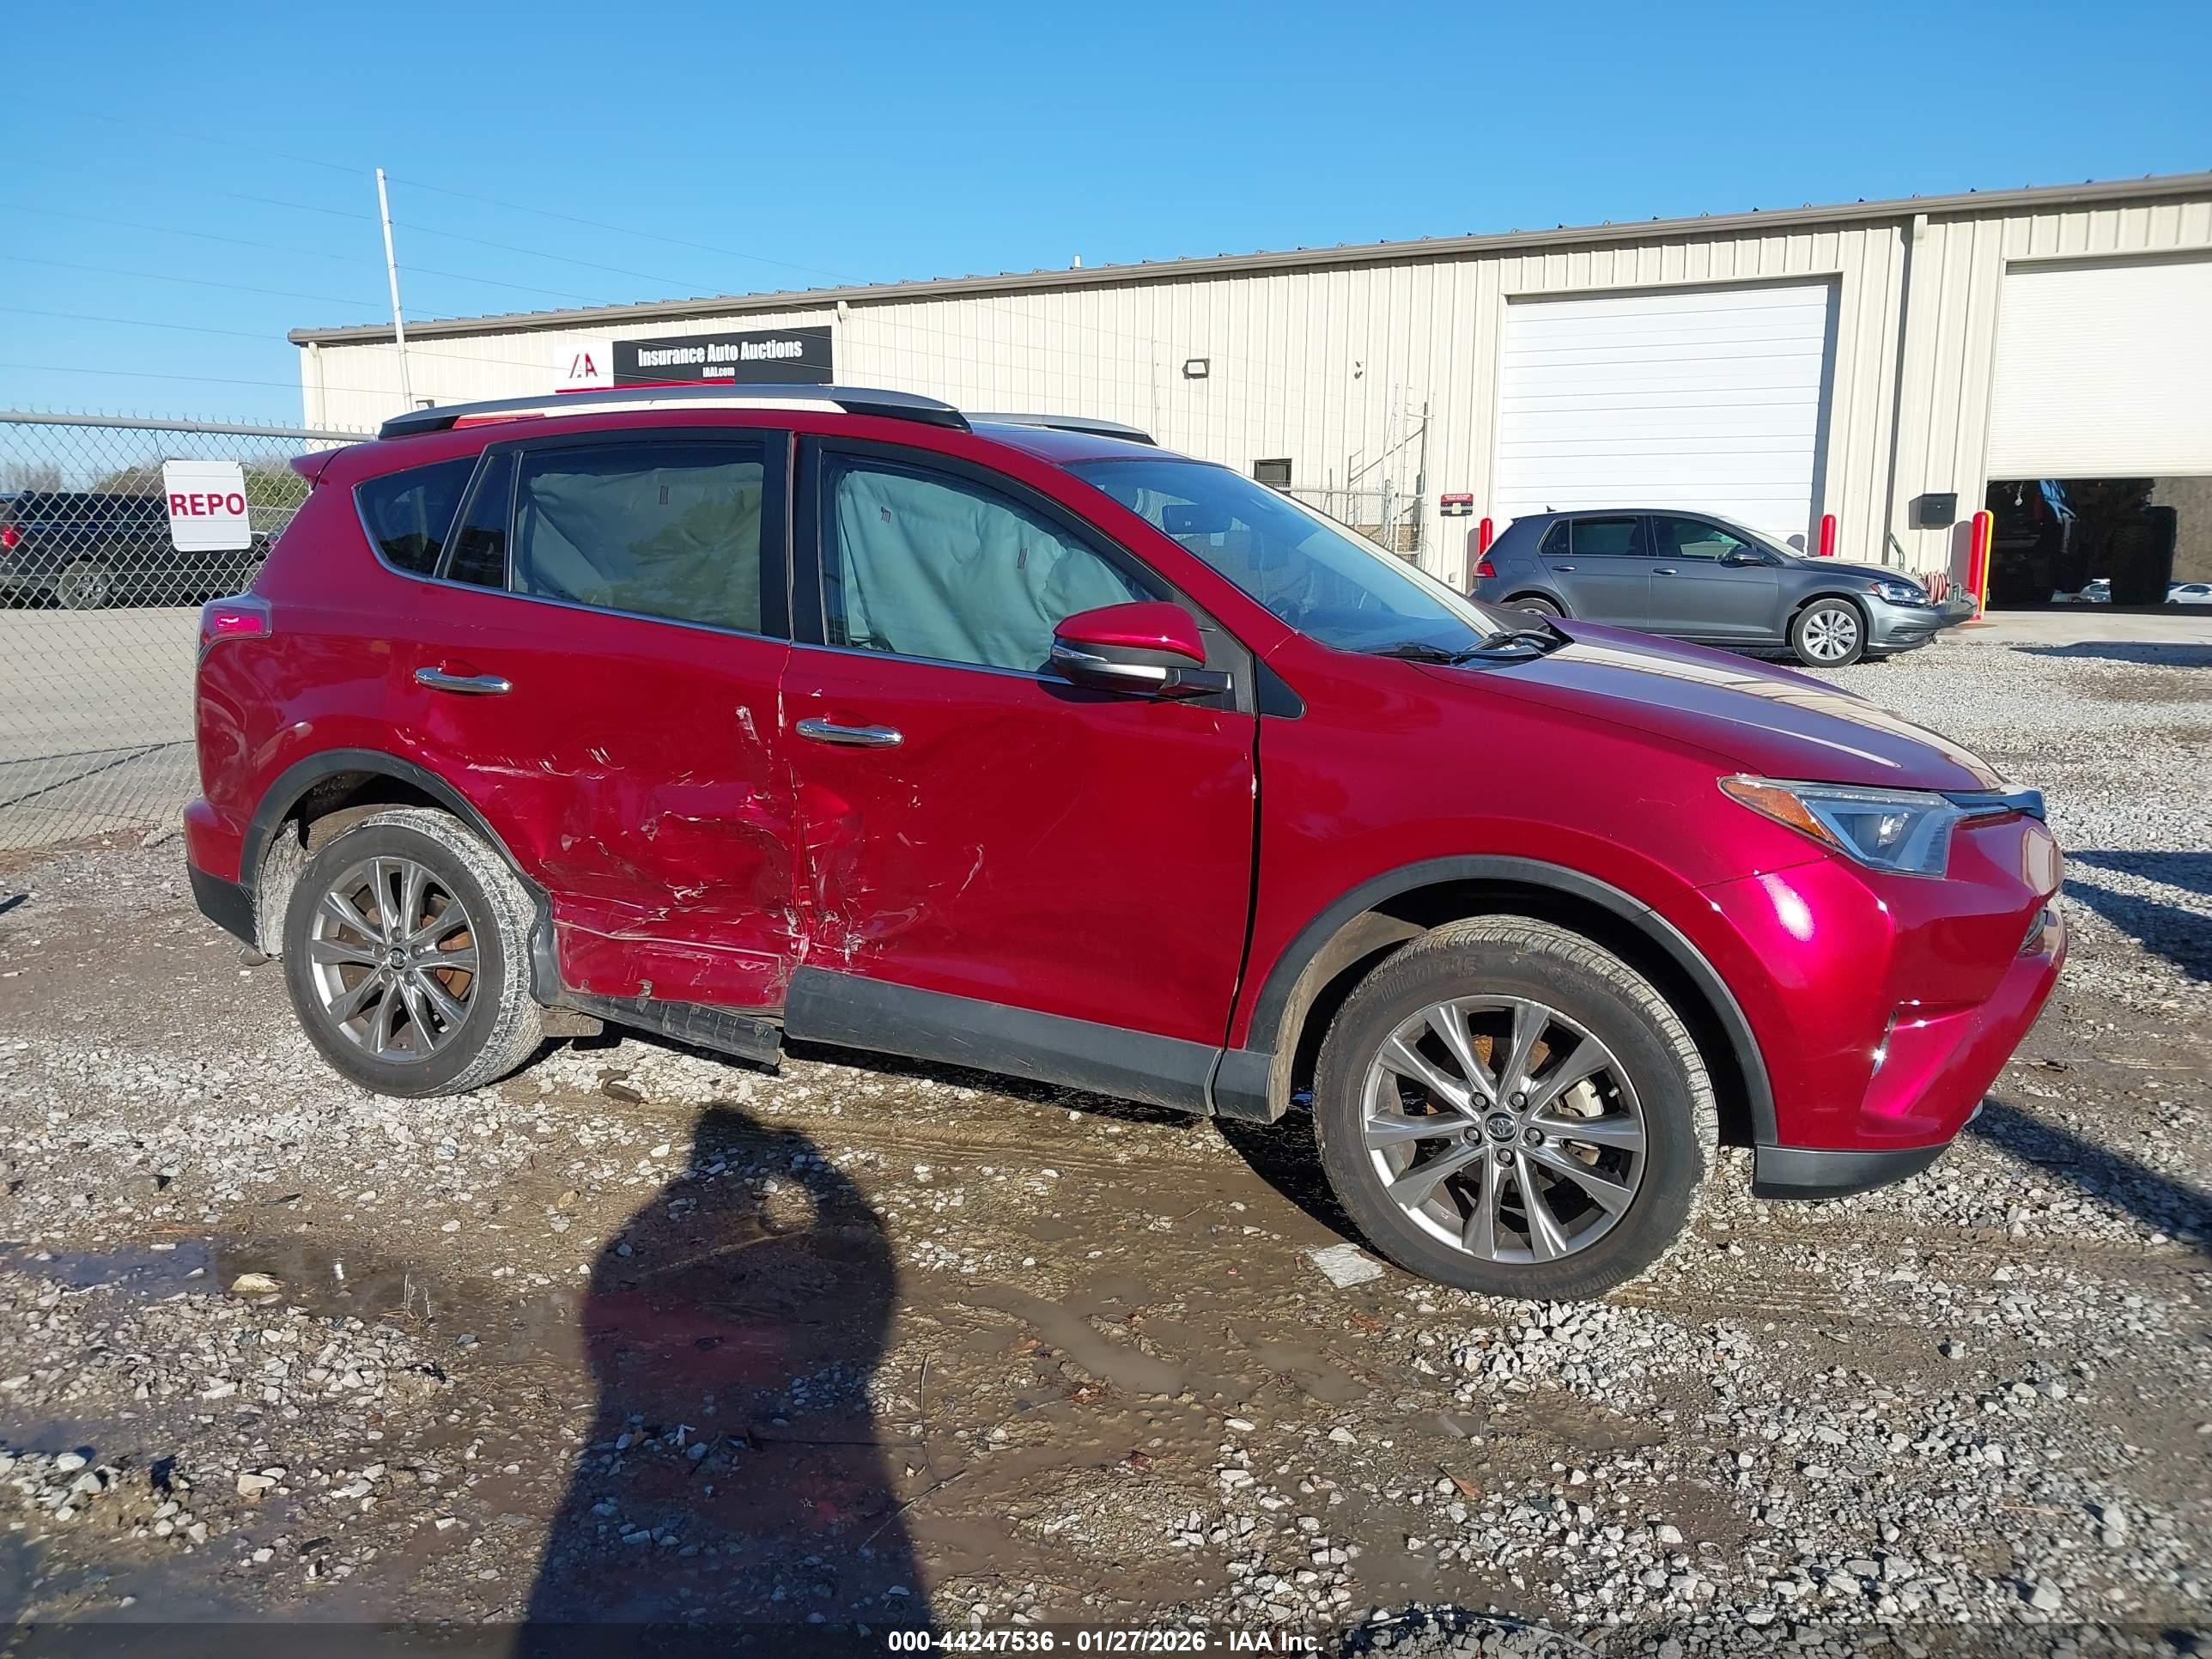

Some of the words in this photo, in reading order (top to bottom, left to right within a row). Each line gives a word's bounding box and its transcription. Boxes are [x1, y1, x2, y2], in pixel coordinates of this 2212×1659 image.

[637, 347, 705, 367] Insurance
[707, 343, 738, 362] Auto
[740, 340, 803, 361] Auctions
[169, 493, 245, 516] REPO
